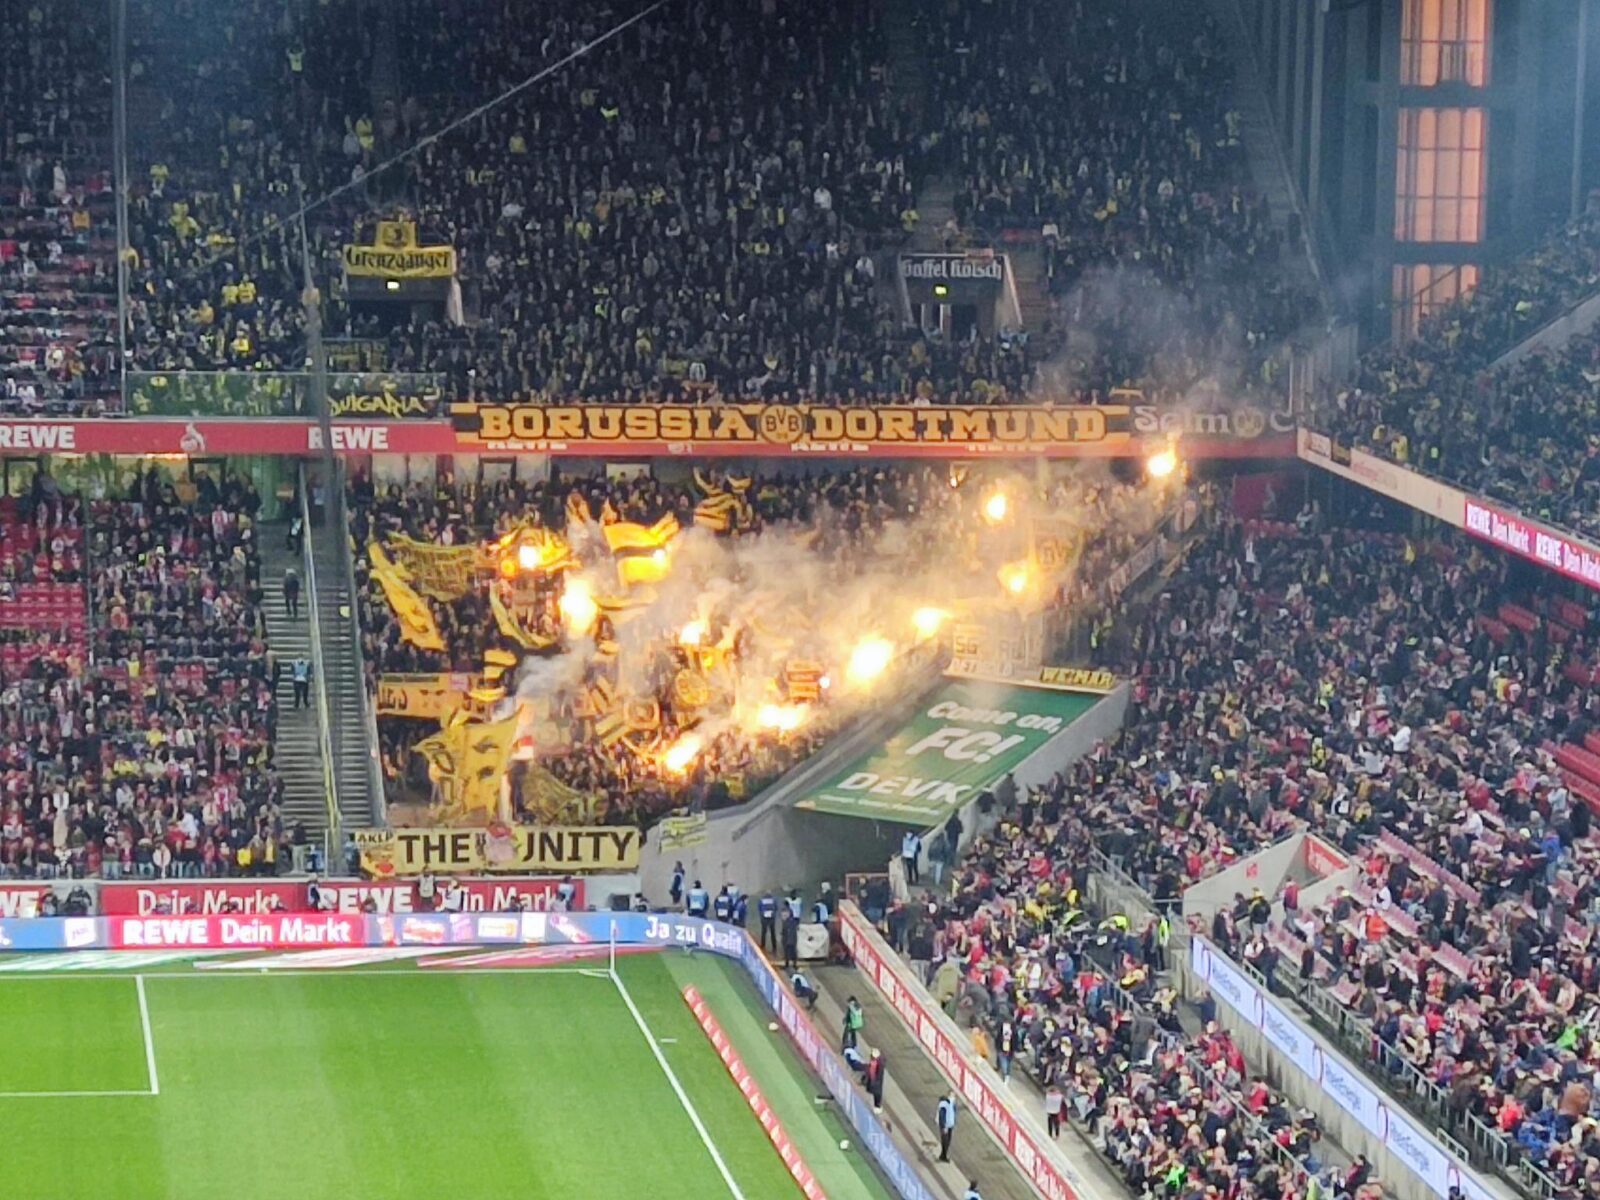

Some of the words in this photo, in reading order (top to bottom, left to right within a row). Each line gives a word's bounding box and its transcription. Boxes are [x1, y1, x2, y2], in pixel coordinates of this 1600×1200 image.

[0, 425, 76, 449] REWE
[479, 406, 758, 441] BORUSSIA
[765, 407, 799, 432] BVB
[810, 405, 1107, 442] DORTMUND
[308, 427, 389, 449] REWE
[927, 701, 1017, 725] Come
[905, 727, 1025, 763] FC!
[837, 772, 972, 804] DEVK
[398, 834, 470, 864] THE
[123, 919, 208, 945] REWE
[221, 918, 273, 943] Dein
[280, 917, 351, 942] Markt
[646, 916, 670, 939] Ja
[674, 925, 696, 943] zu
